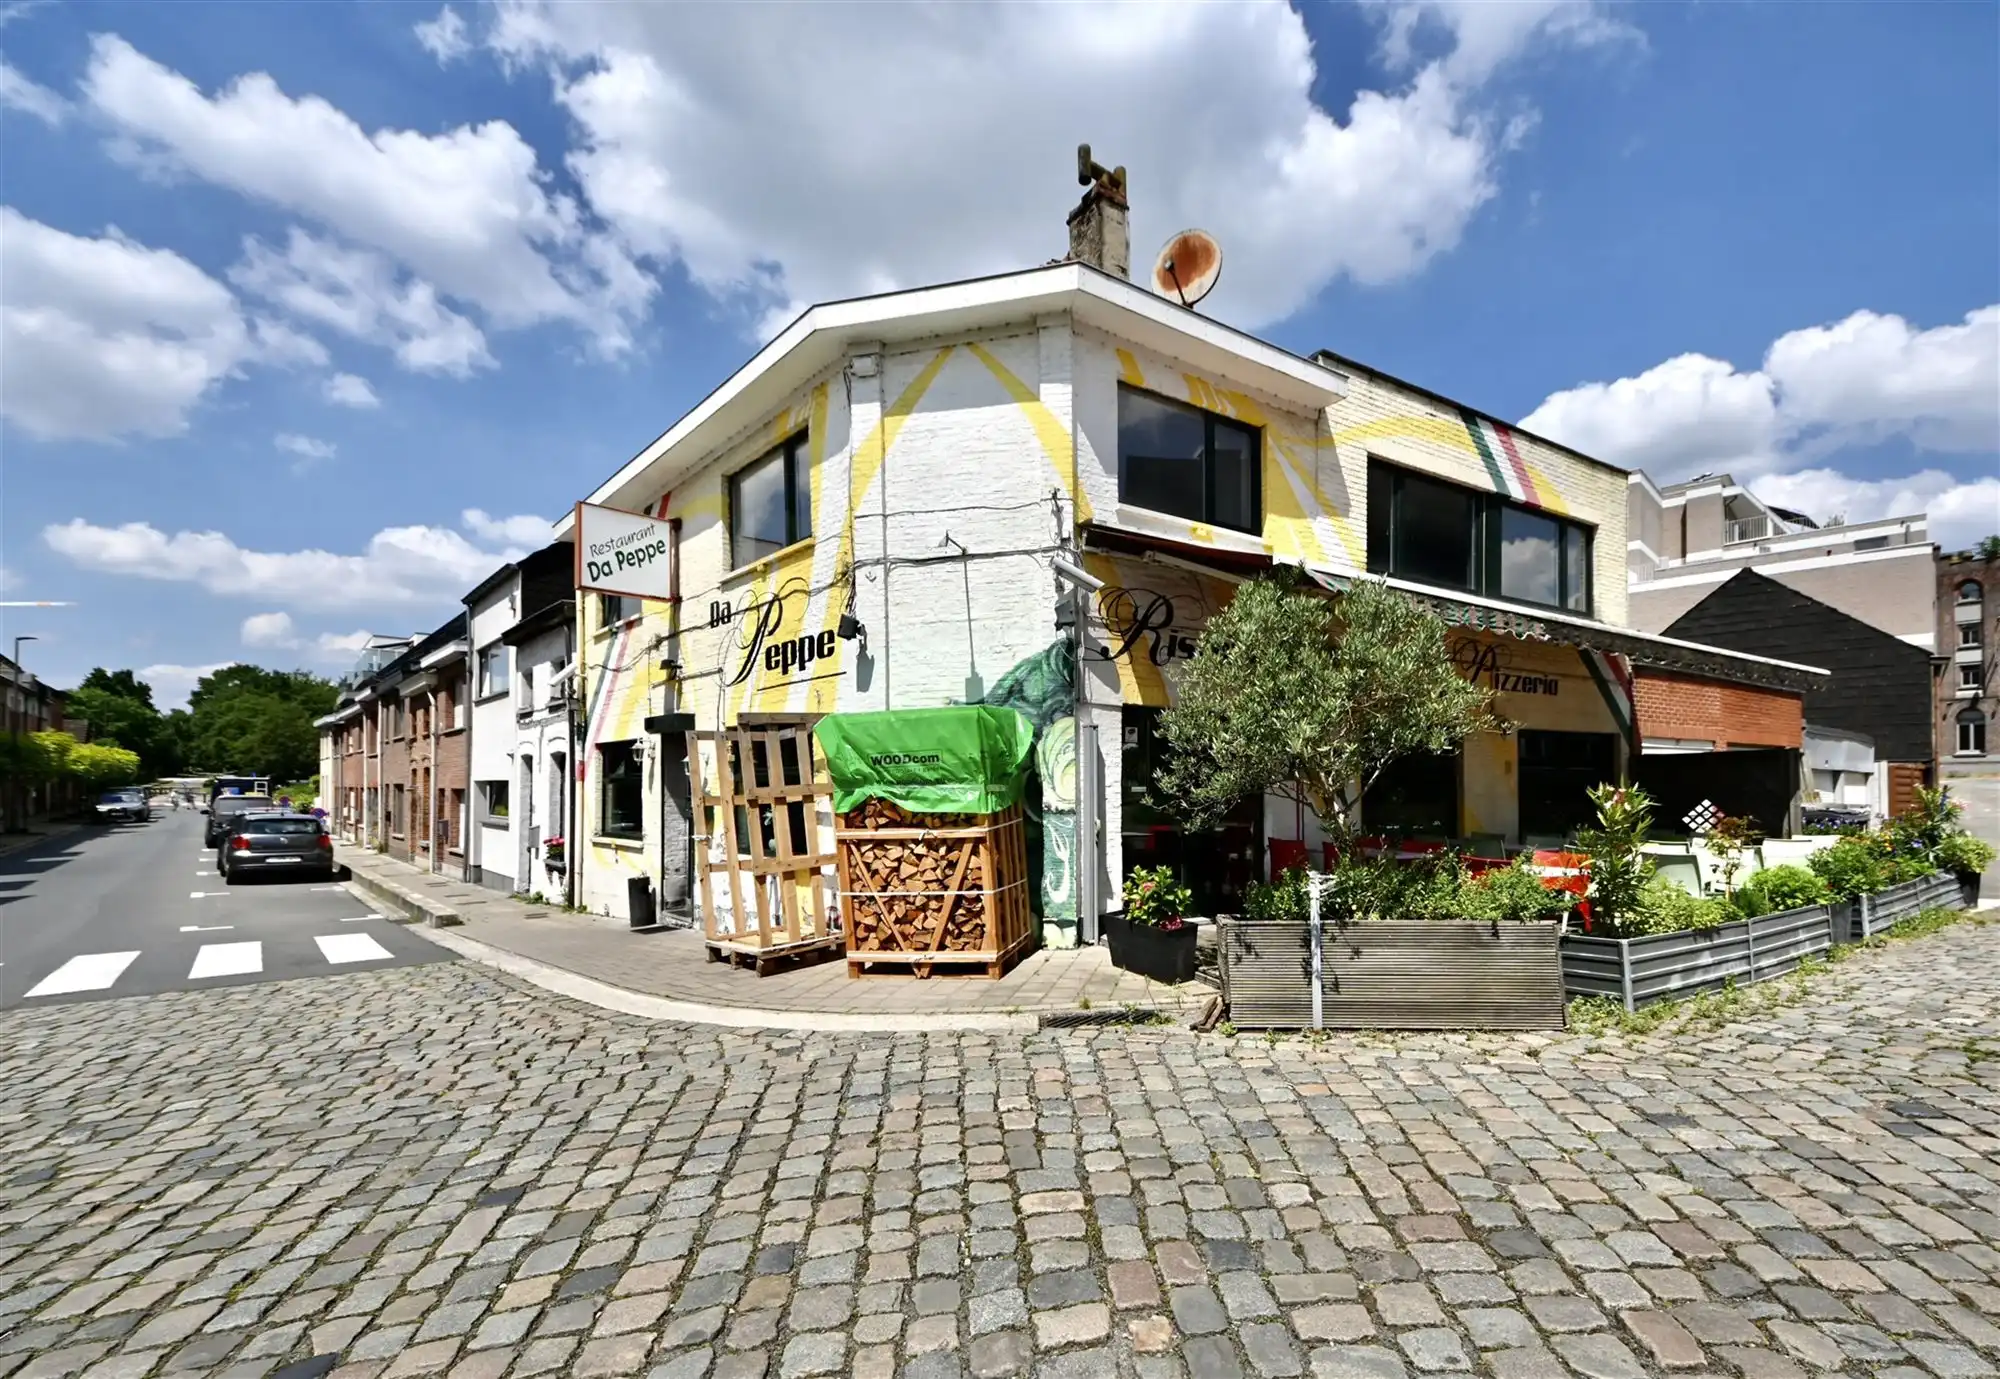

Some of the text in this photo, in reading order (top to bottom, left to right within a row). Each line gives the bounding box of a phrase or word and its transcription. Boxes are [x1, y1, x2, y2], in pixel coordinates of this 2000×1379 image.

[589, 523, 656, 557] Restaurant
[587, 539, 667, 583] Da Peppe
[710, 600, 732, 628] Da
[718, 577, 835, 687] Peppe
[1452, 637, 1559, 696] Pizzeria
[870, 753, 940, 766] WOODcom
